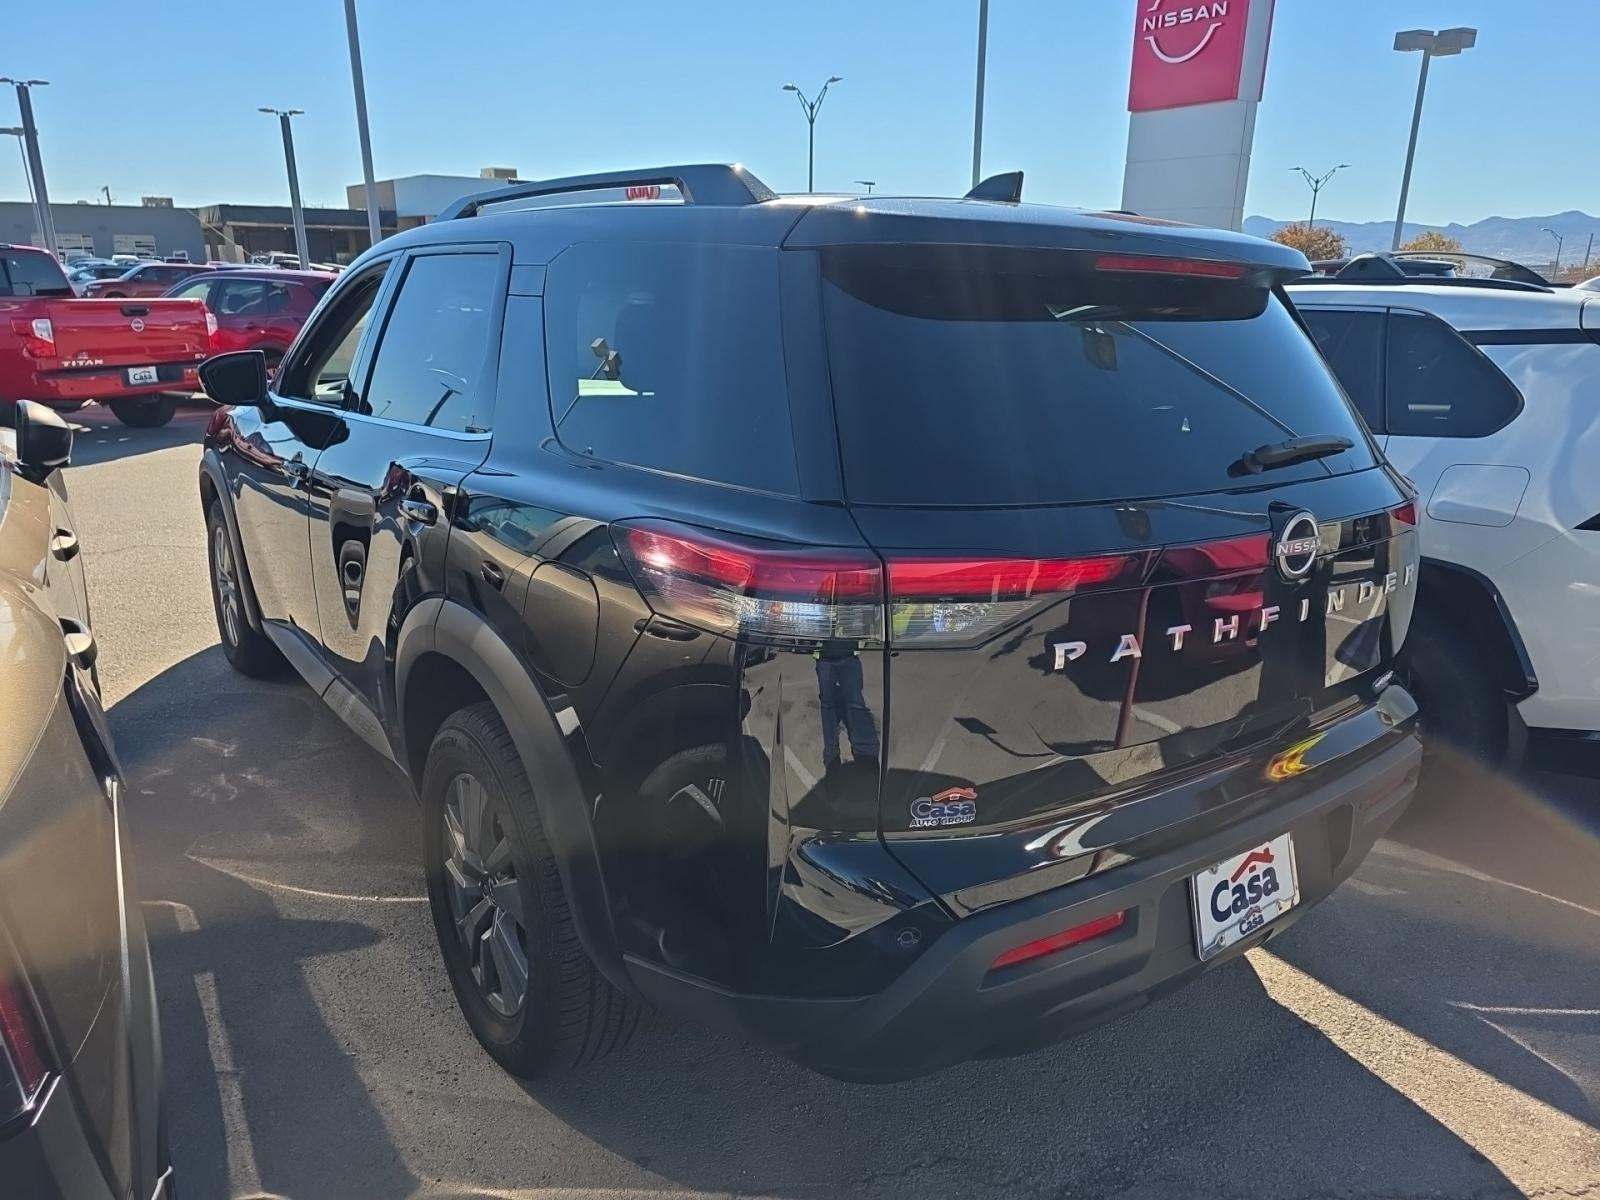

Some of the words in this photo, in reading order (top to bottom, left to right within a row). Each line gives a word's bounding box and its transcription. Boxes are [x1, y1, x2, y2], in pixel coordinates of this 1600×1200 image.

[1142, 1, 1228, 31] NISSAN
[61, 359, 104, 367] TITAN
[133, 373, 153, 381] Casa
[1277, 536, 1322, 556] NISSAN
[1053, 563, 1415, 670] PATHFINDER
[910, 796, 977, 819] Casa
[908, 818, 940, 828] AUTO
[940, 815, 976, 825] GROUP
[1210, 866, 1280, 923] Casa
[1239, 914, 1265, 935] Casa
